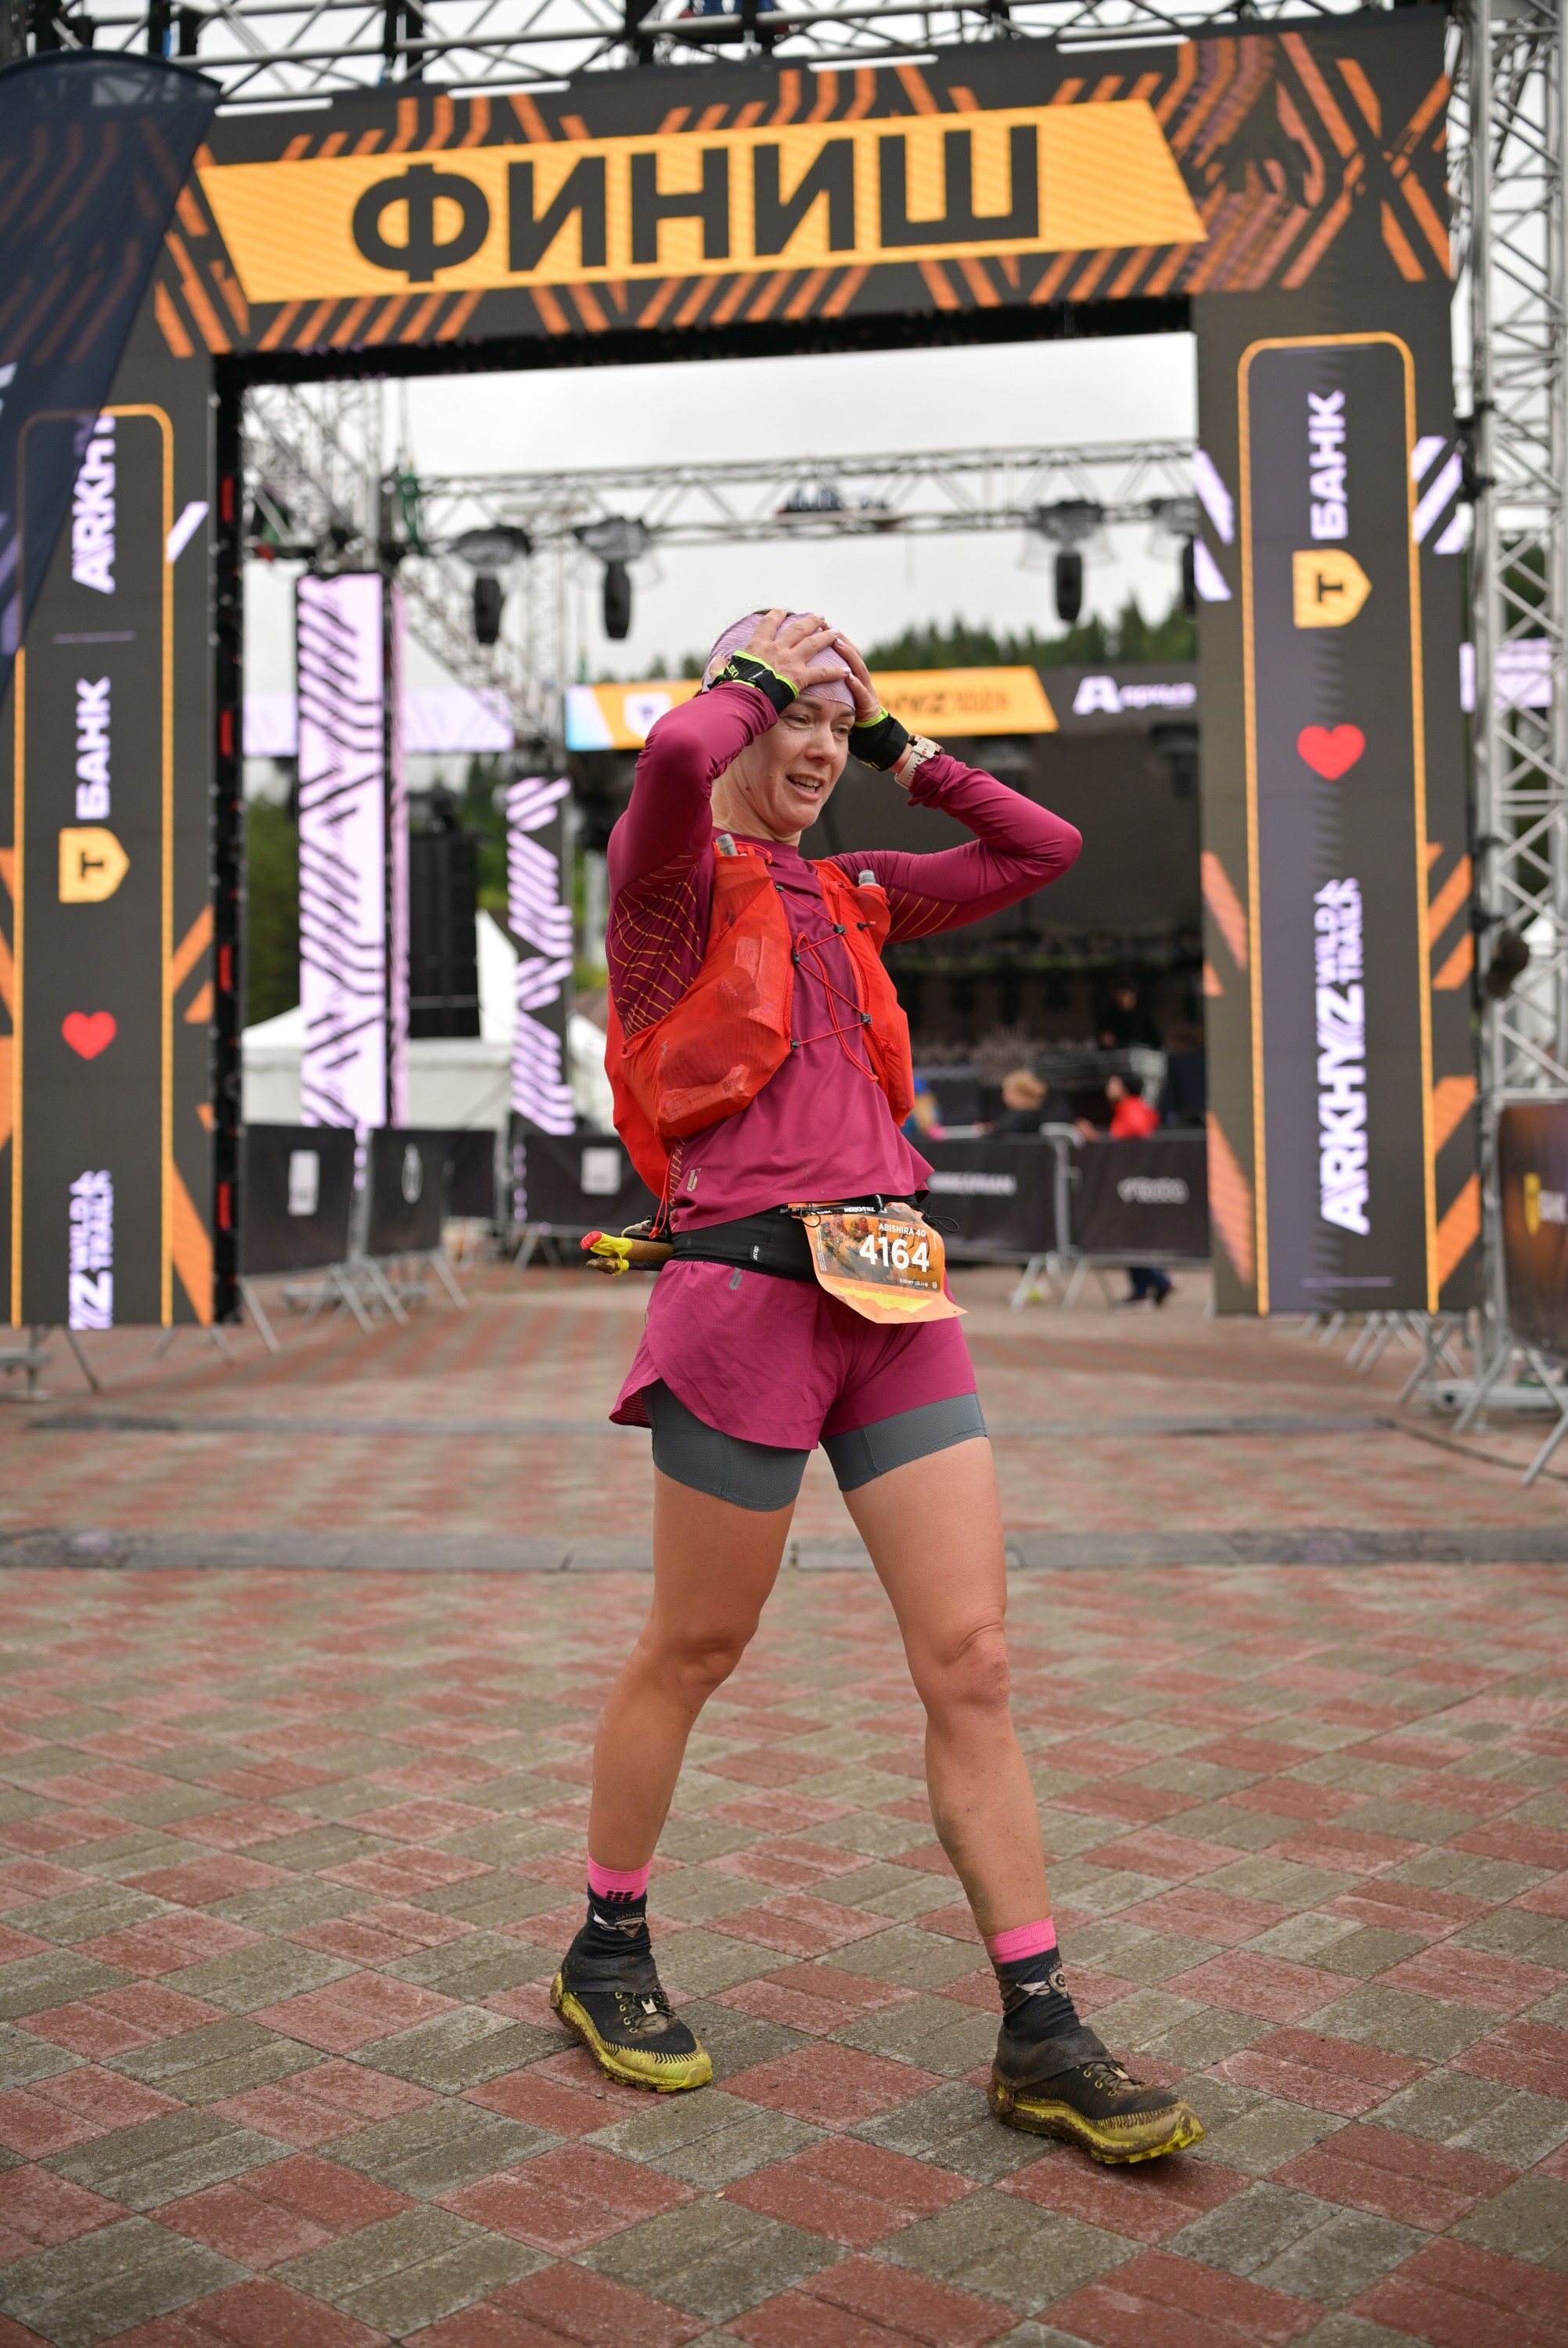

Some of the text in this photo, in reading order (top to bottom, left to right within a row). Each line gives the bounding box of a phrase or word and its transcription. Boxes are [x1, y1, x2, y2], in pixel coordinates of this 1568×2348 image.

[352, 124, 1039, 283] ФИНИШ
[1307, 391, 1348, 540] БАНК
[76, 677, 110, 820] БАНК
[1314, 985, 1370, 1235] ARKHYZ
[859, 1234, 930, 1273] 4164
[878, 1223, 926, 1237] ABISHIRA 40
